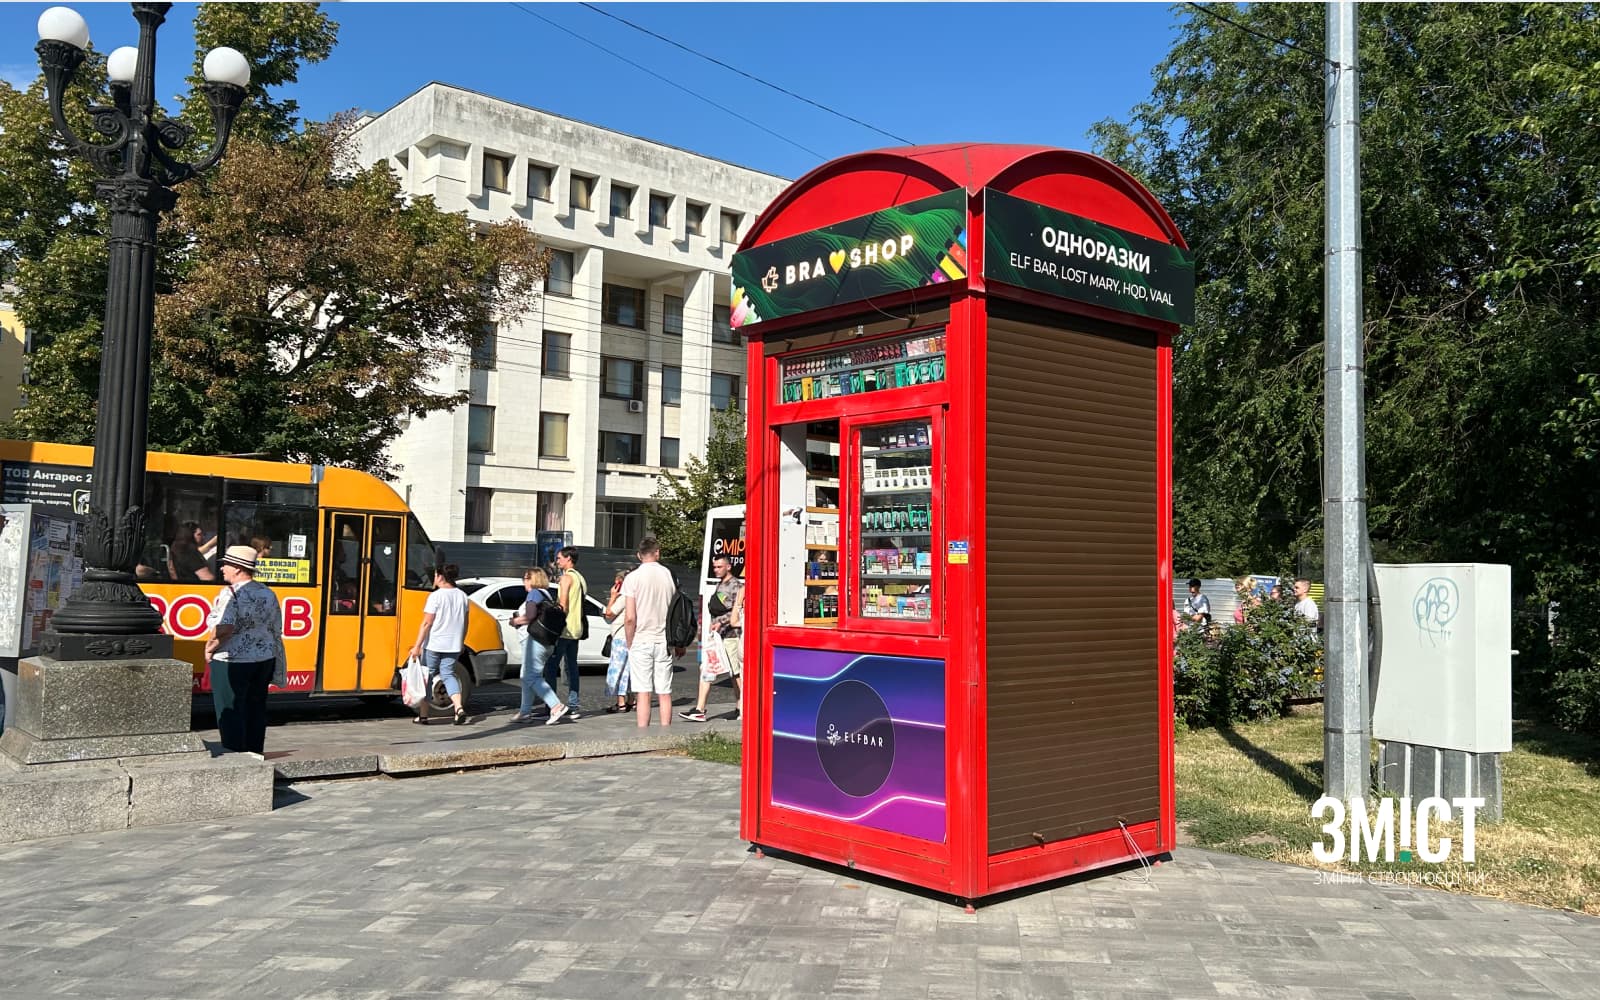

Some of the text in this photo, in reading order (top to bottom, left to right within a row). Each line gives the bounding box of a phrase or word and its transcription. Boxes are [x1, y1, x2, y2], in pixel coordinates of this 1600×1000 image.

[785, 234, 914, 285] BRA SHOP
[1042, 227, 1151, 275] ОДНОРАЗКИ
[1010, 252, 1175, 306] ELF BAR, LOST MARY, HQD, VAAL
[3, 467, 31, 479] ТОВ
[33, 469, 83, 484] Антарес
[844, 731, 884, 748] ELFBAR
